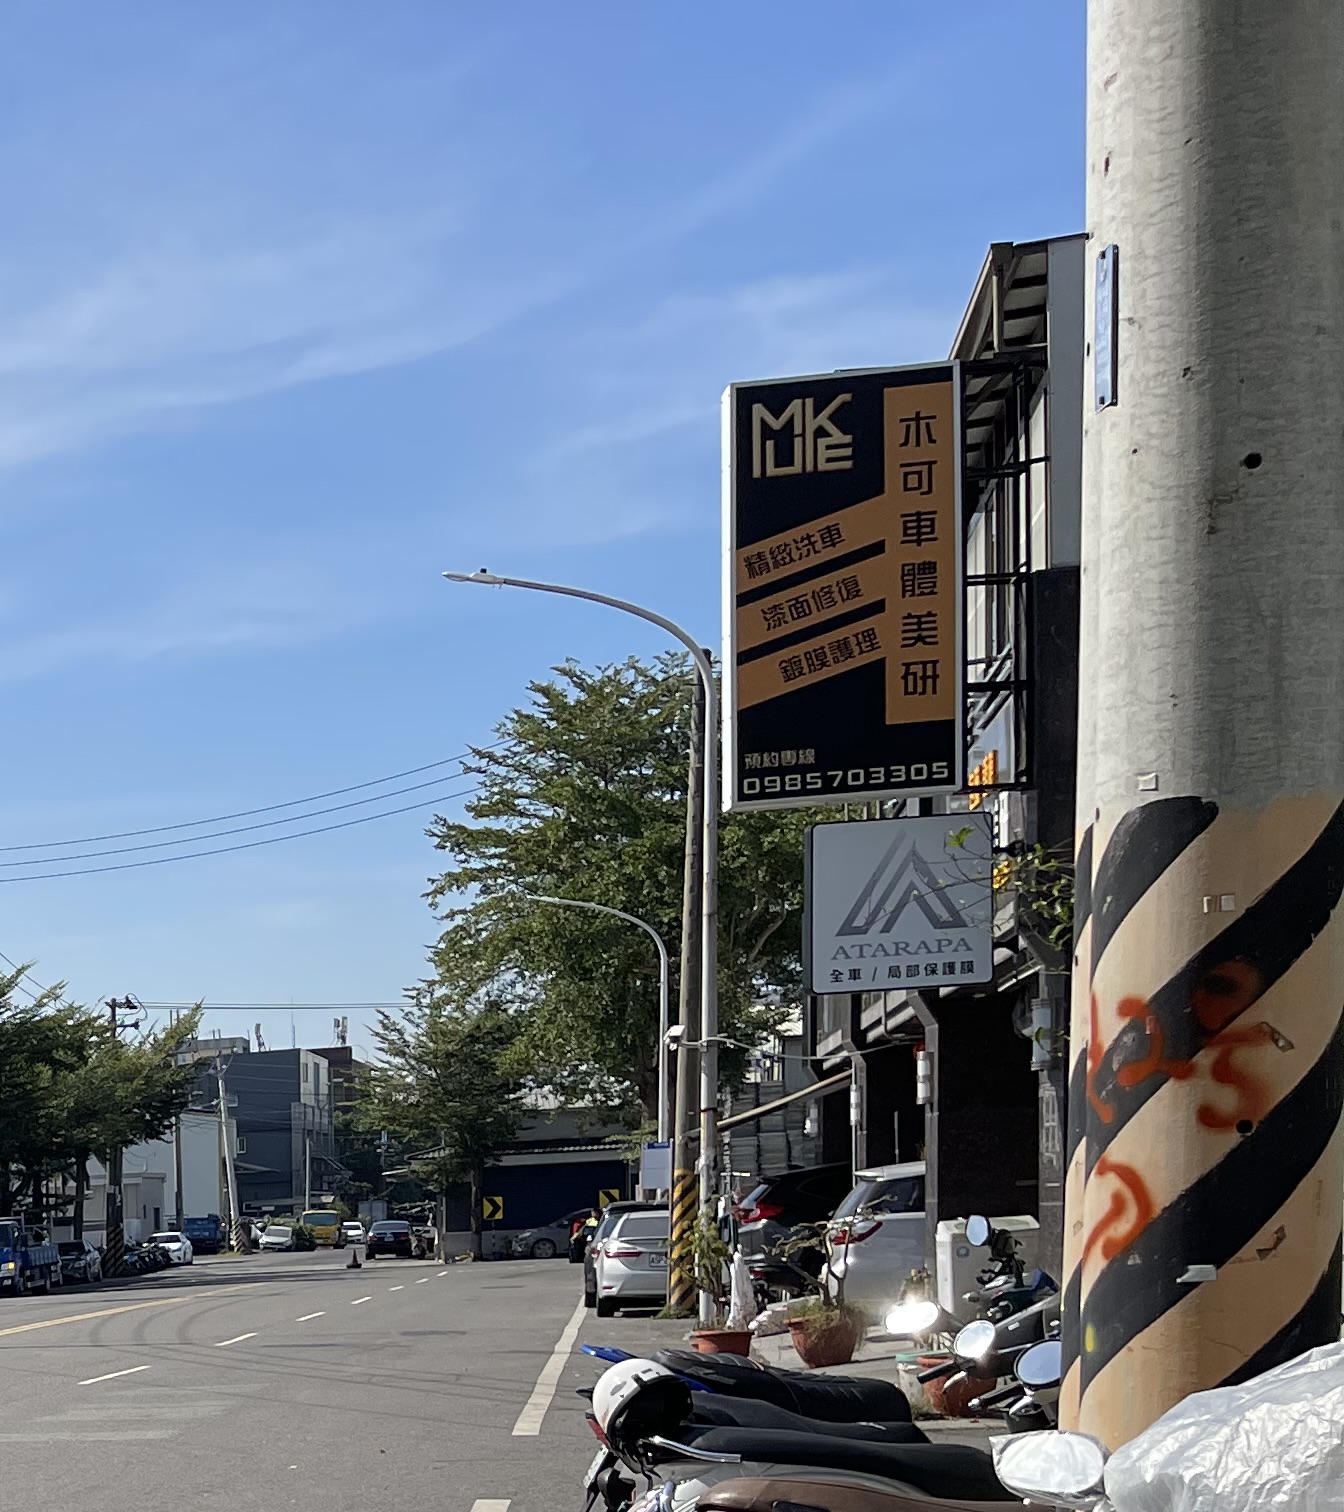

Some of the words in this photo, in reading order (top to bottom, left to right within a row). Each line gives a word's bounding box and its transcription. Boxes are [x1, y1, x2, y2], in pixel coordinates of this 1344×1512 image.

[743, 522, 846, 579] 精緻洗車
[899, 410, 939, 697] 木可車體美研
[761, 574, 864, 632] 漆面修復
[778, 626, 882, 683] 鍍膜護理
[743, 761, 949, 794] 0985703305
[744, 749, 816, 770] 預約專線
[830, 937, 974, 960] ATARAPA
[887, 960, 975, 979] 局部保護膜
